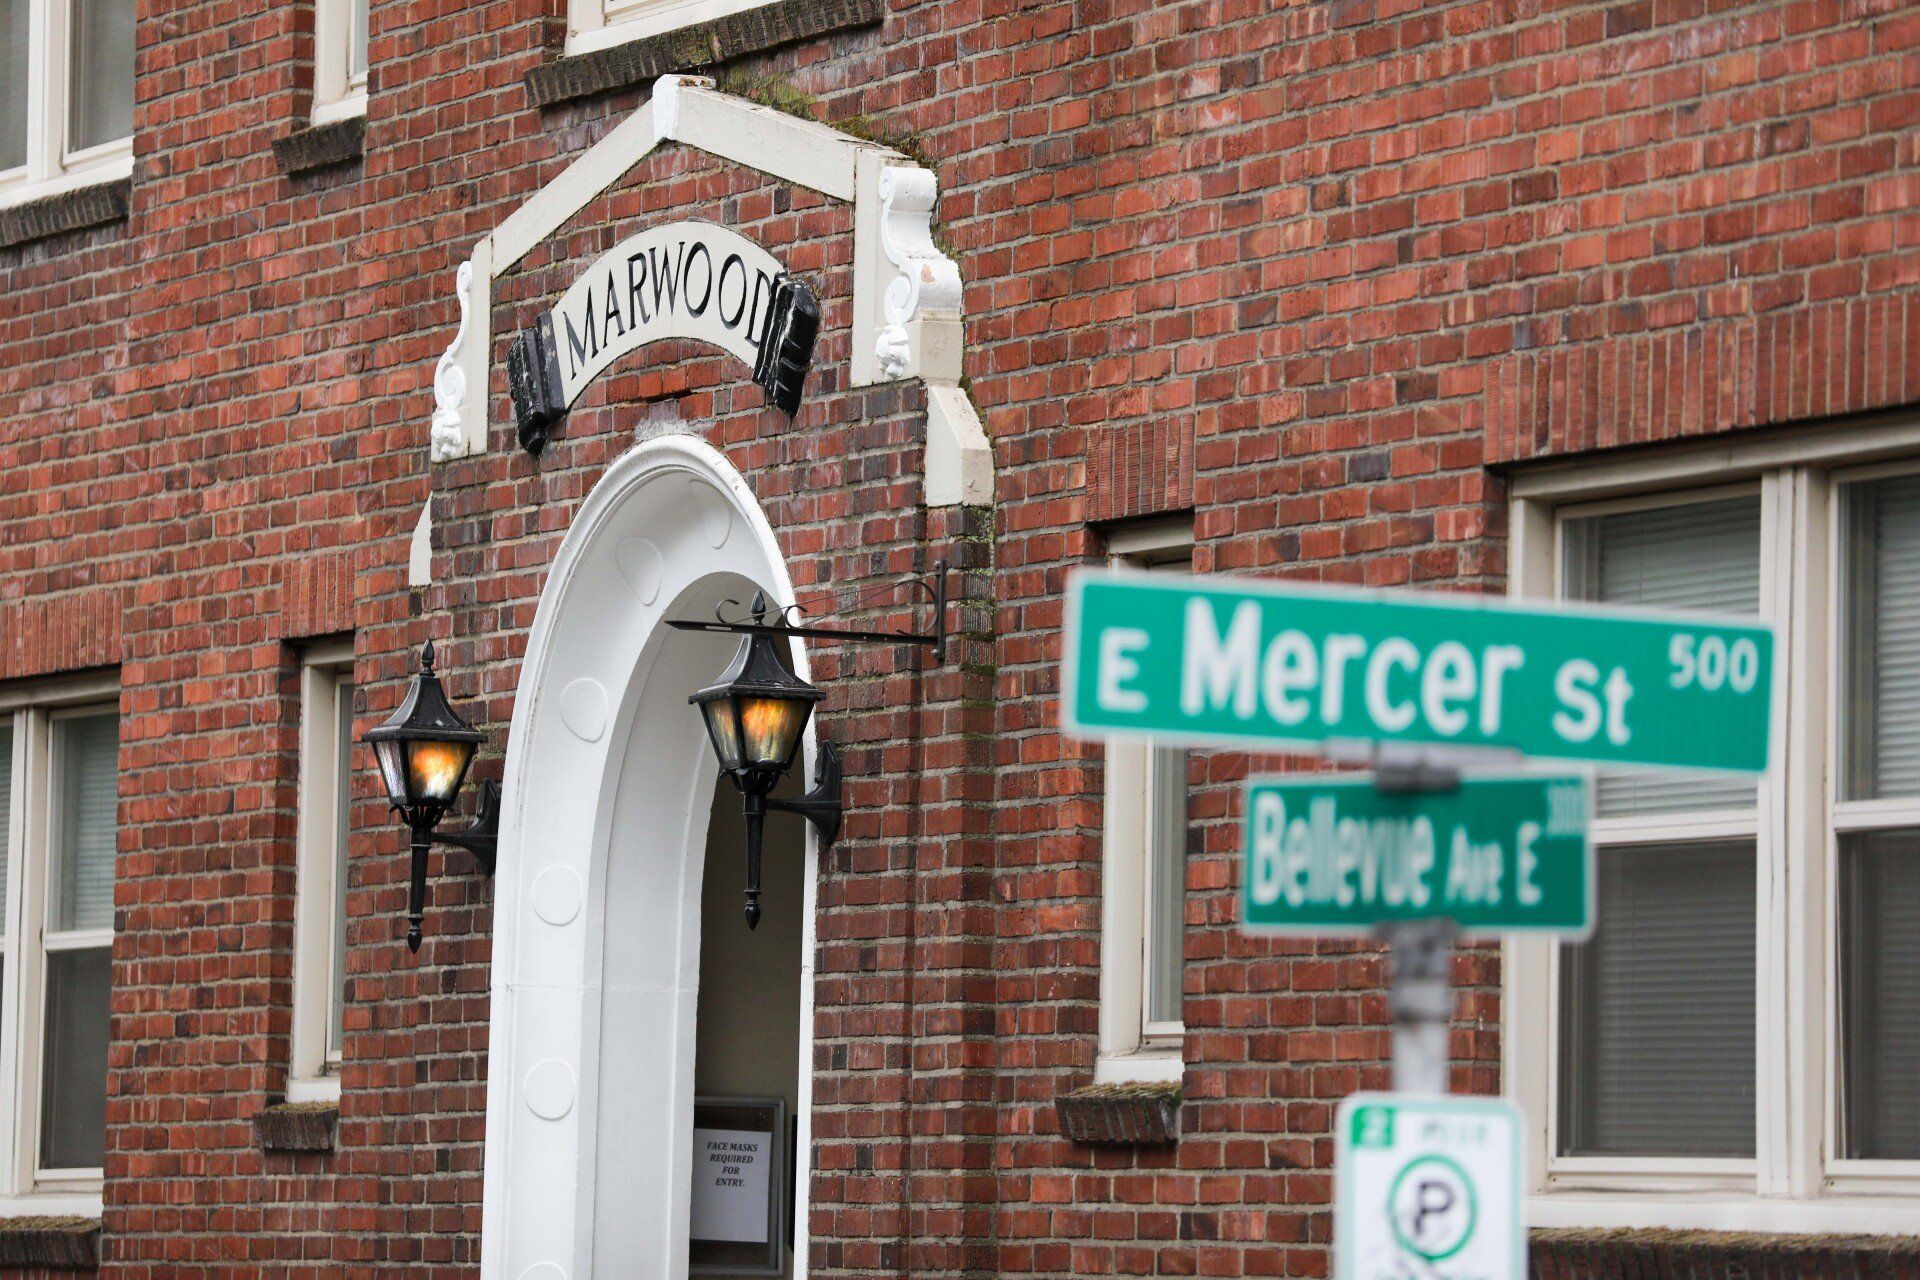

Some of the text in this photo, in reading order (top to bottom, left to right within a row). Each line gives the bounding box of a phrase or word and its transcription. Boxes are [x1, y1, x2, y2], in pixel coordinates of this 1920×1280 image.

[563, 241, 771, 381] MARWOOD
[1097, 596, 1758, 745] E Mercer St 500
[1254, 790, 1543, 908] Bellevue Ave E
[706, 1142, 758, 1152] FACE MASKS
[709, 1153, 754, 1164] REQUIRED
[715, 1177, 745, 1187] ENTRY.
[722, 1166, 740, 1175] FOR
[1413, 1180, 1455, 1236] P
